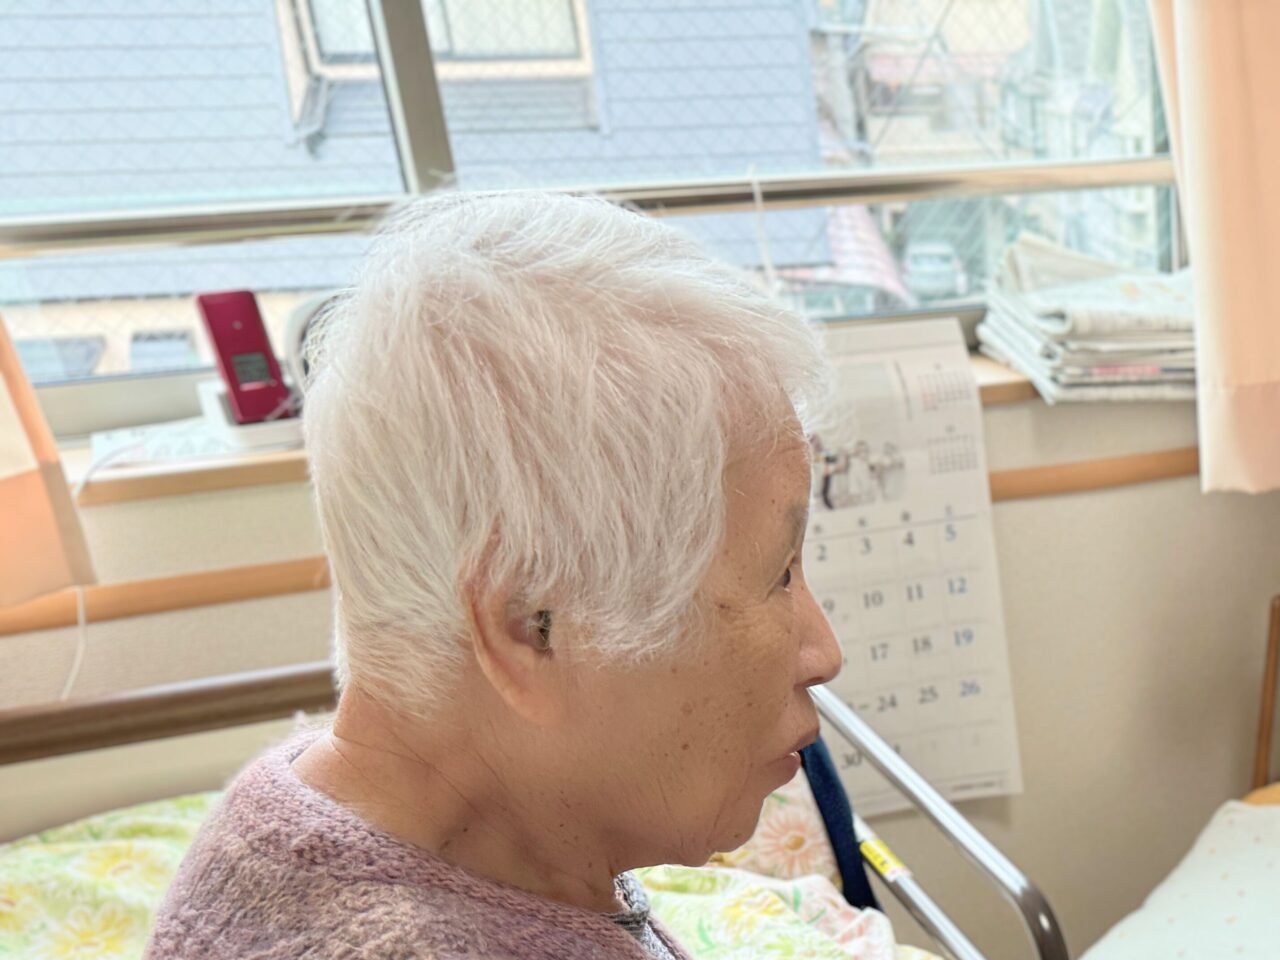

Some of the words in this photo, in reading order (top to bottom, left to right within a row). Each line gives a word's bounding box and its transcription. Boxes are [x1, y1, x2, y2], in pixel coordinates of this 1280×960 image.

[816, 544, 827, 562] 2
[860, 536, 872, 555] 3
[903, 531, 915, 547] 4
[945, 523, 957, 541] 5
[863, 590, 884, 609] 10
[906, 583, 923, 602] 11
[948, 576, 968, 595] 12
[870, 642, 889, 661] 17
[913, 636, 932, 654] 18
[954, 629, 974, 647] 19
[878, 694, 897, 712] 24
[919, 686, 938, 704] 25
